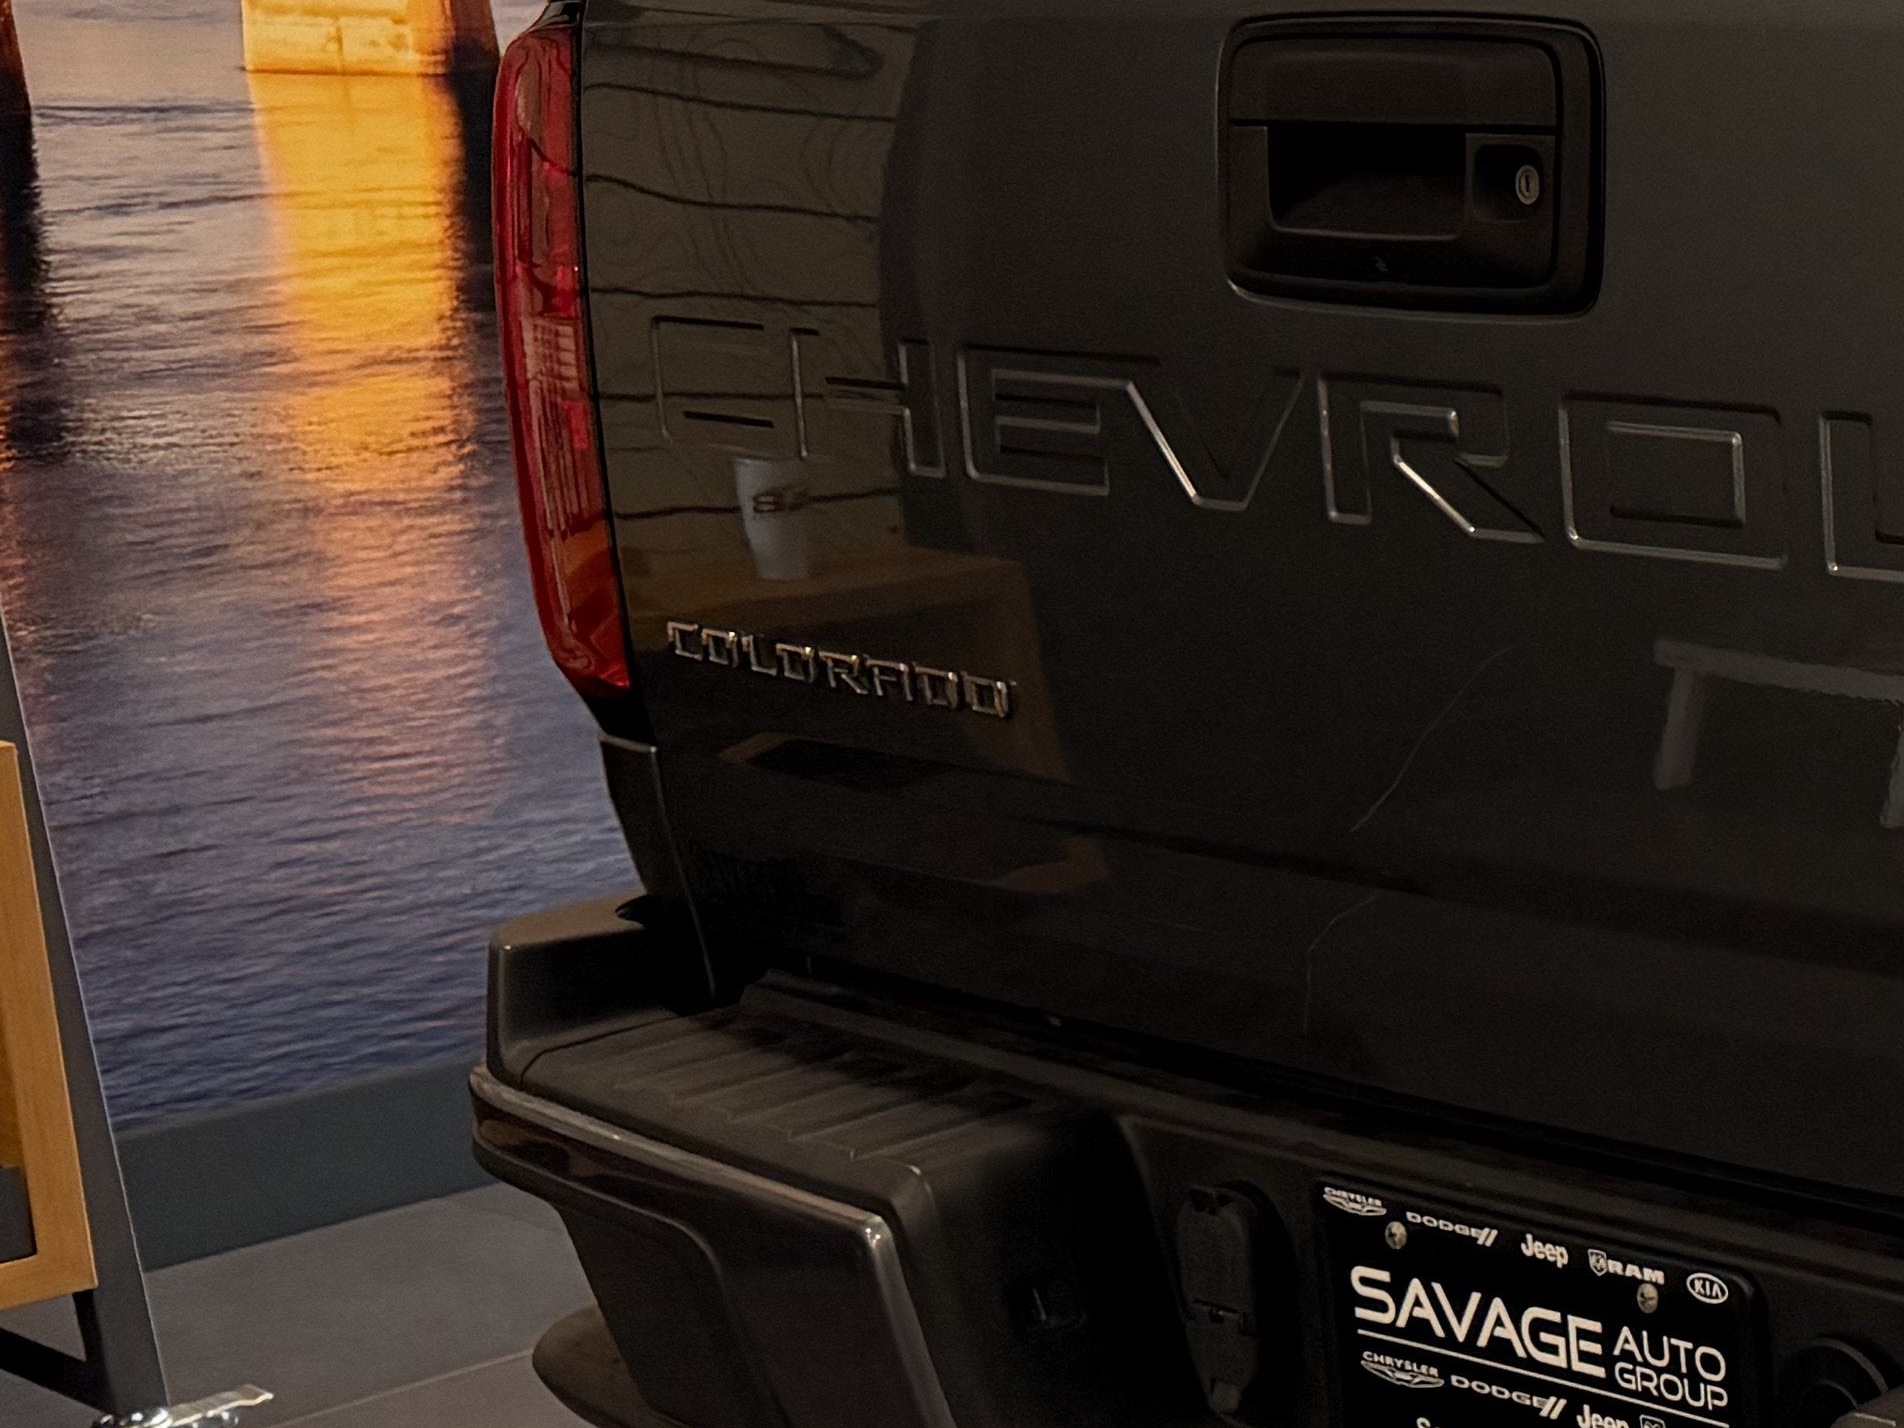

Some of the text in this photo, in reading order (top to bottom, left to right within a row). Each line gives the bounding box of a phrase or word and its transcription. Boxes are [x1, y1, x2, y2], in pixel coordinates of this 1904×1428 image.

[666, 620, 1014, 718] COLORADO
[1521, 1233, 1569, 1268] Jeep
[1607, 1258, 1665, 1285] RAM
[1350, 1265, 1726, 1382] SAVAGE AUTO
[1362, 1351, 1439, 1378] CHRYSLER
[1450, 1374, 1551, 1410] DODGE
[1615, 1362, 1729, 1411] GROUP
